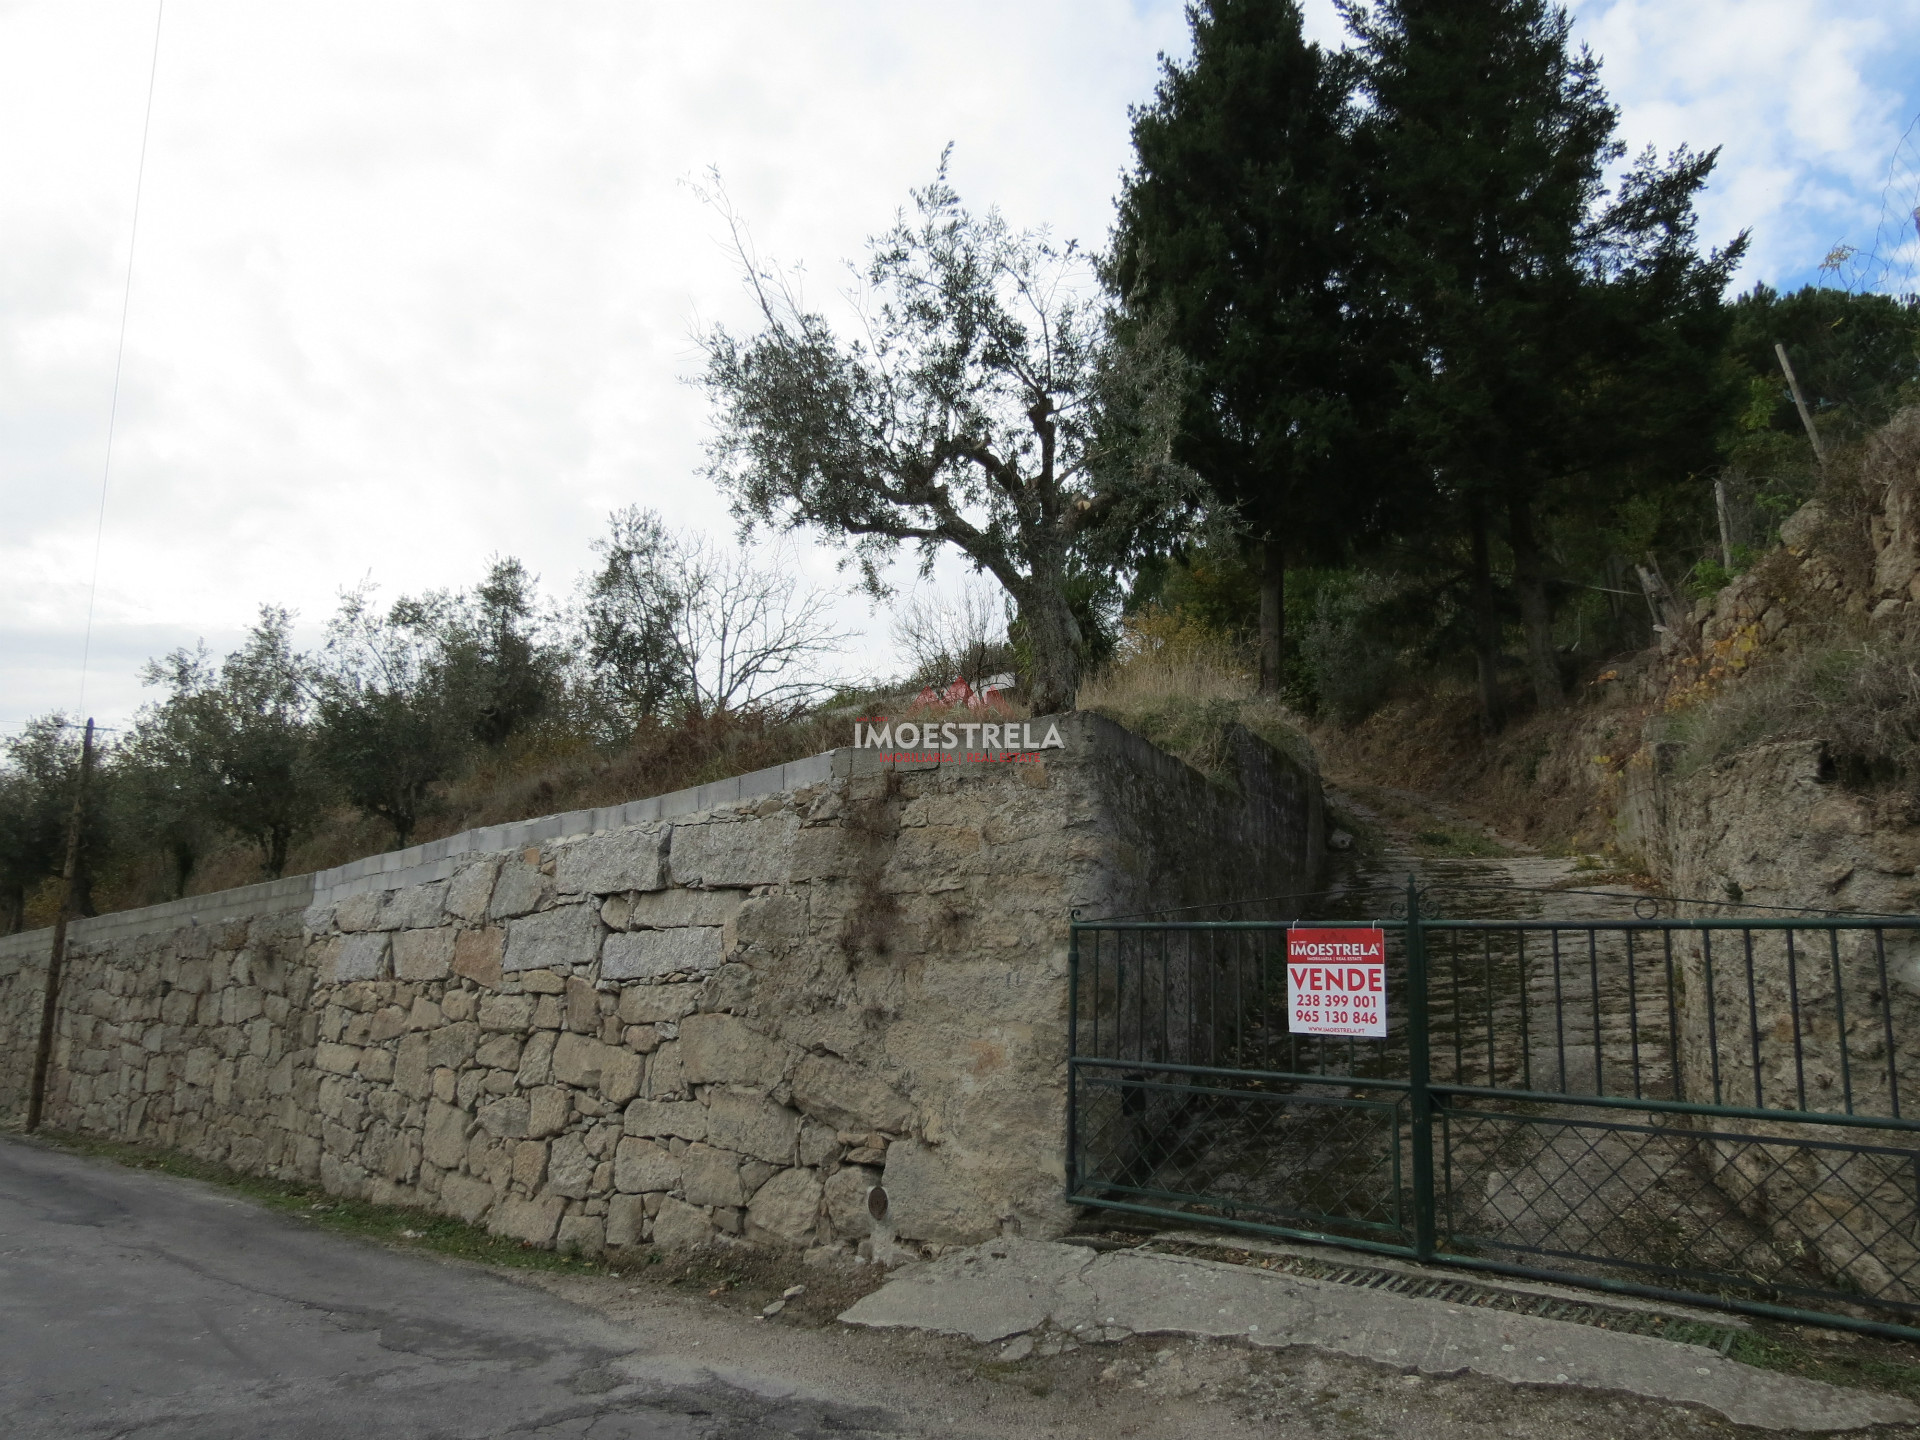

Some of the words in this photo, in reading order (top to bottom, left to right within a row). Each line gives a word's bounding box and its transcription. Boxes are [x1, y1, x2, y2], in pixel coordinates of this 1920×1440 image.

[1290, 943, 1379, 956] IMOESTRELA
[1289, 968, 1382, 992] VENDE
[1296, 994, 1320, 1007] 238
[1324, 995, 1349, 1007] 399
[1353, 995, 1376, 1008] 001
[1296, 1010, 1319, 1022] 965
[1325, 1010, 1348, 1023] 130
[1352, 1011, 1378, 1024] 846
